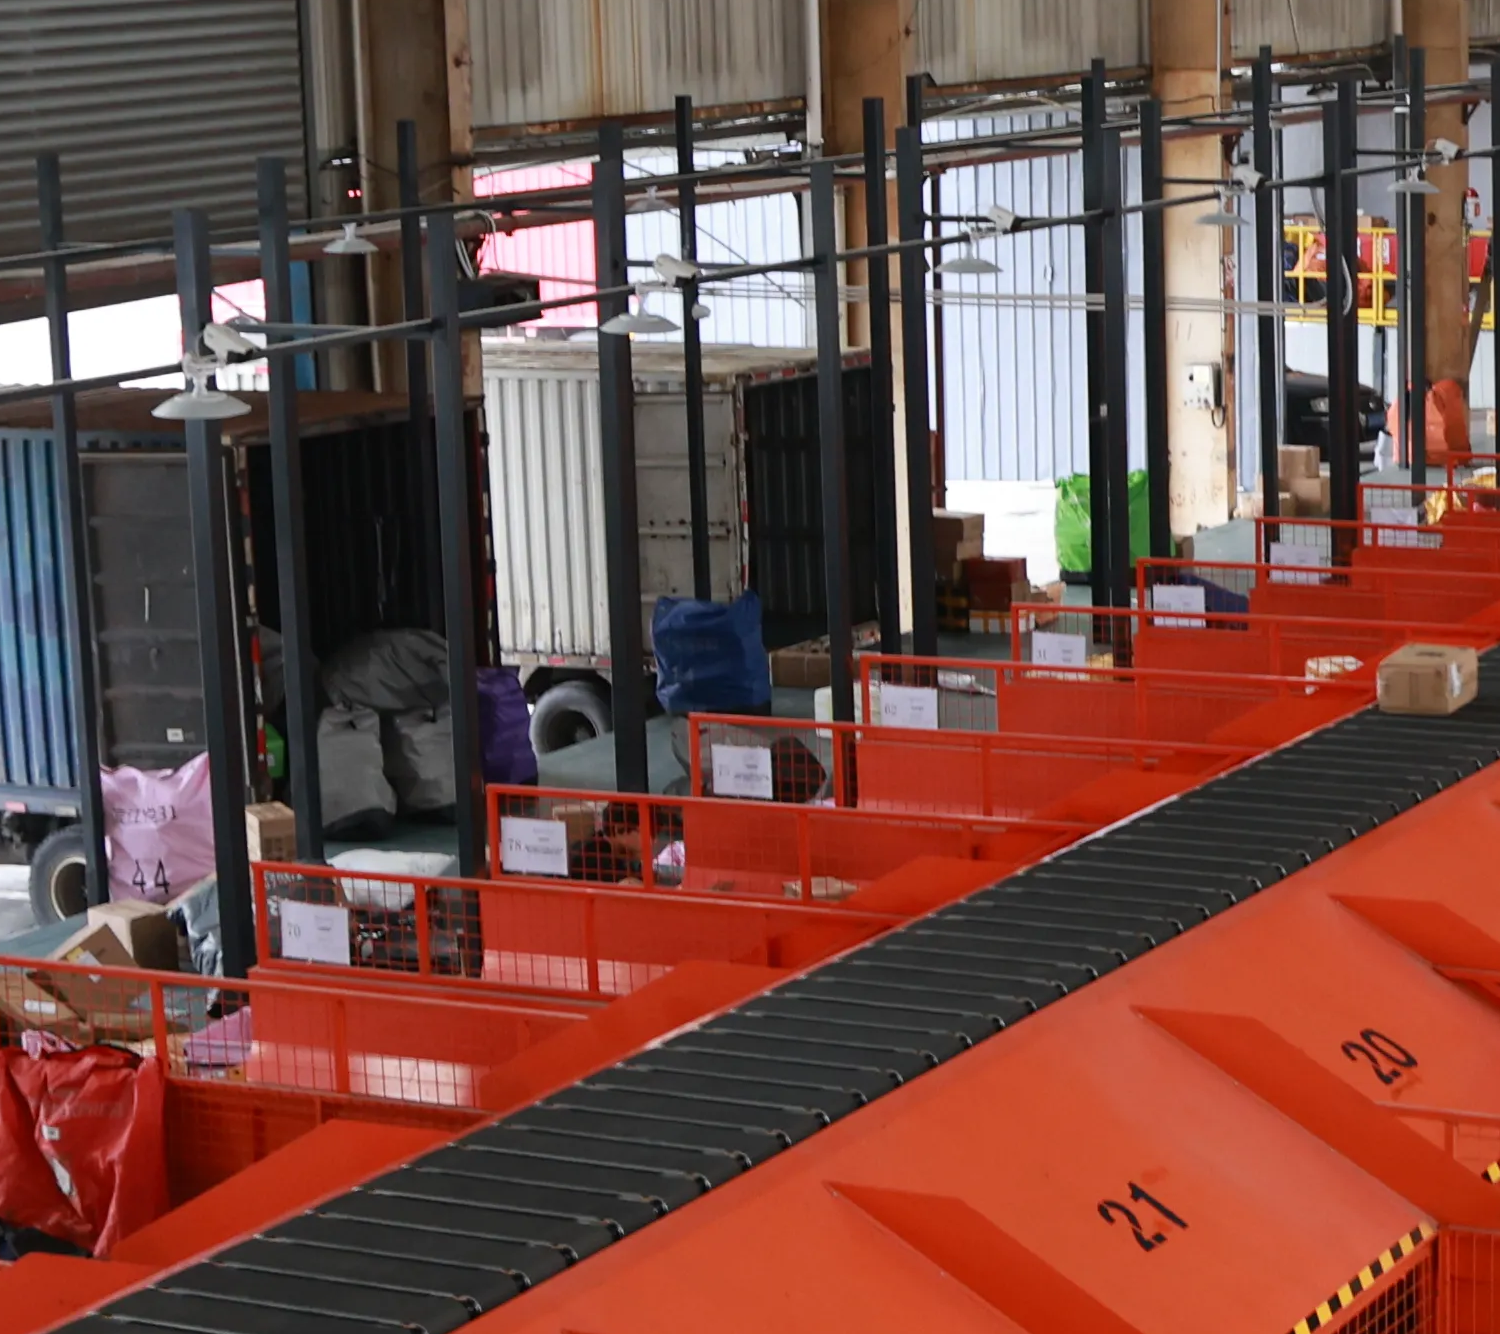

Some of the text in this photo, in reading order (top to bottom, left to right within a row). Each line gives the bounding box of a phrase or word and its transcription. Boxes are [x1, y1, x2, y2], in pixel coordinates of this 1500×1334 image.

[132, 858, 170, 895] 44
[1341, 1028, 1419, 1085] 20
[1097, 1181, 1188, 1252] 21
